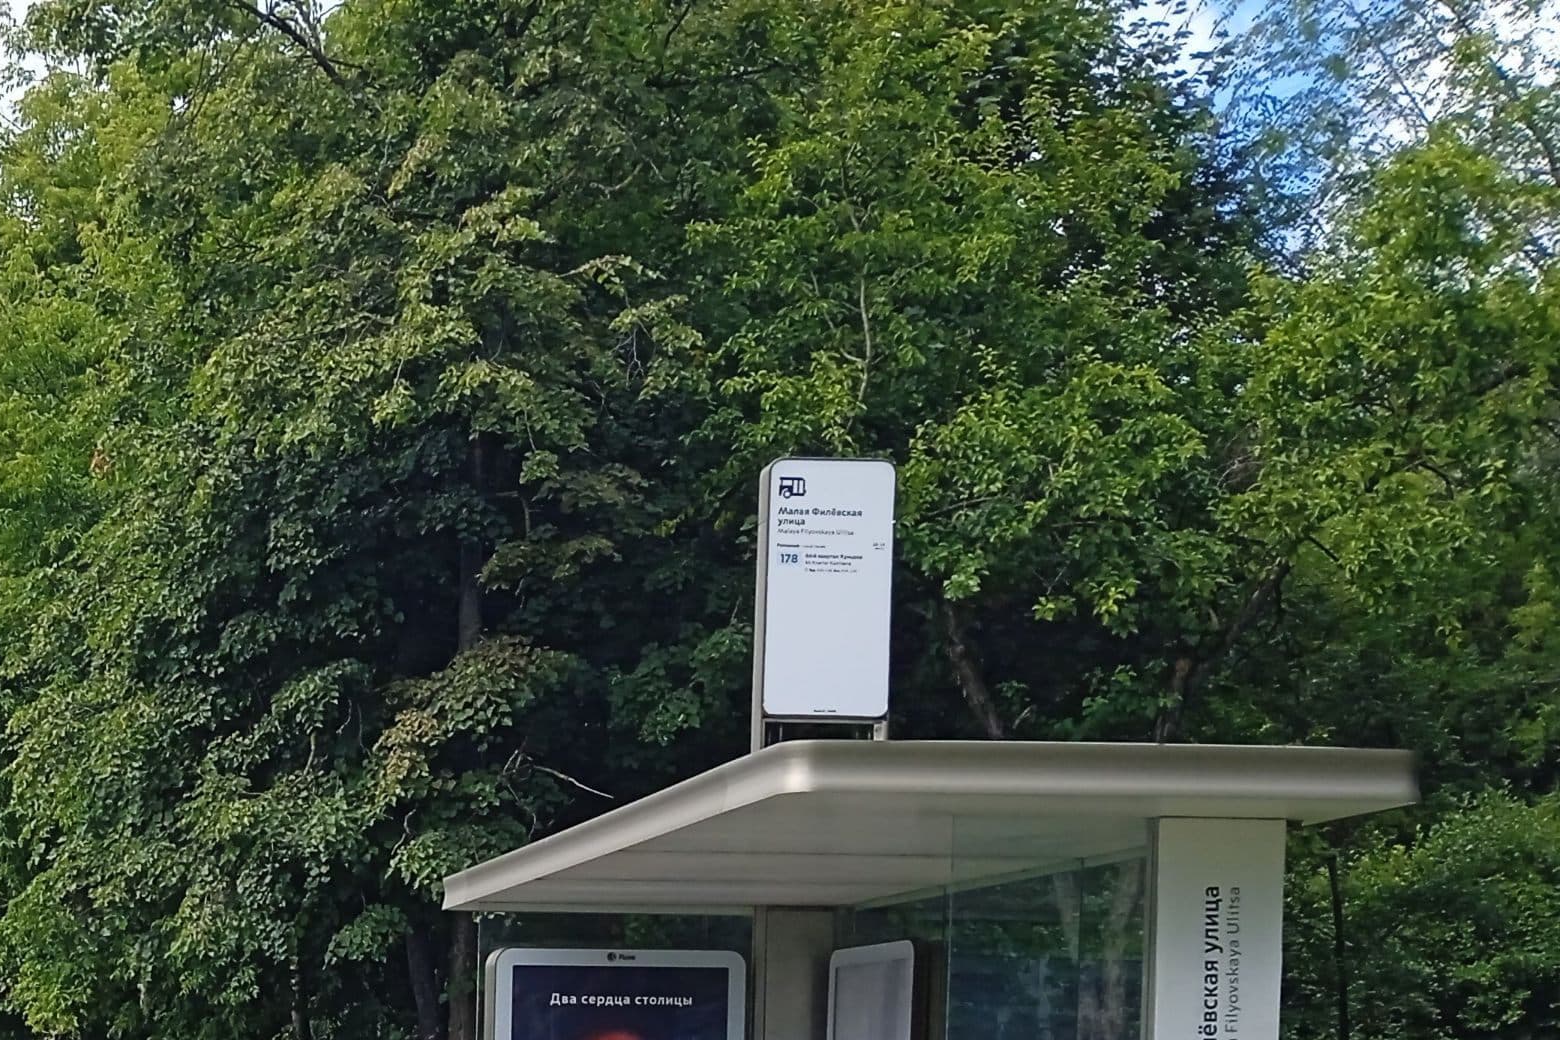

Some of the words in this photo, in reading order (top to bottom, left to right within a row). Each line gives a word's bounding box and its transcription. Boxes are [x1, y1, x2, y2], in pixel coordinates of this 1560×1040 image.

[778, 507, 810, 515] Малая
[812, 508, 863, 517] Филёвская
[777, 519, 806, 527] улица
[780, 554, 799, 564] 178
[1226, 887, 1240, 935] Ulitsa
[1204, 886, 1224, 954] улица
[1224, 939, 1242, 1034] Filyovskaya
[550, 992, 577, 1006] Два
[581, 995, 631, 1007] сердца
[634, 996, 693, 1007] столицы
